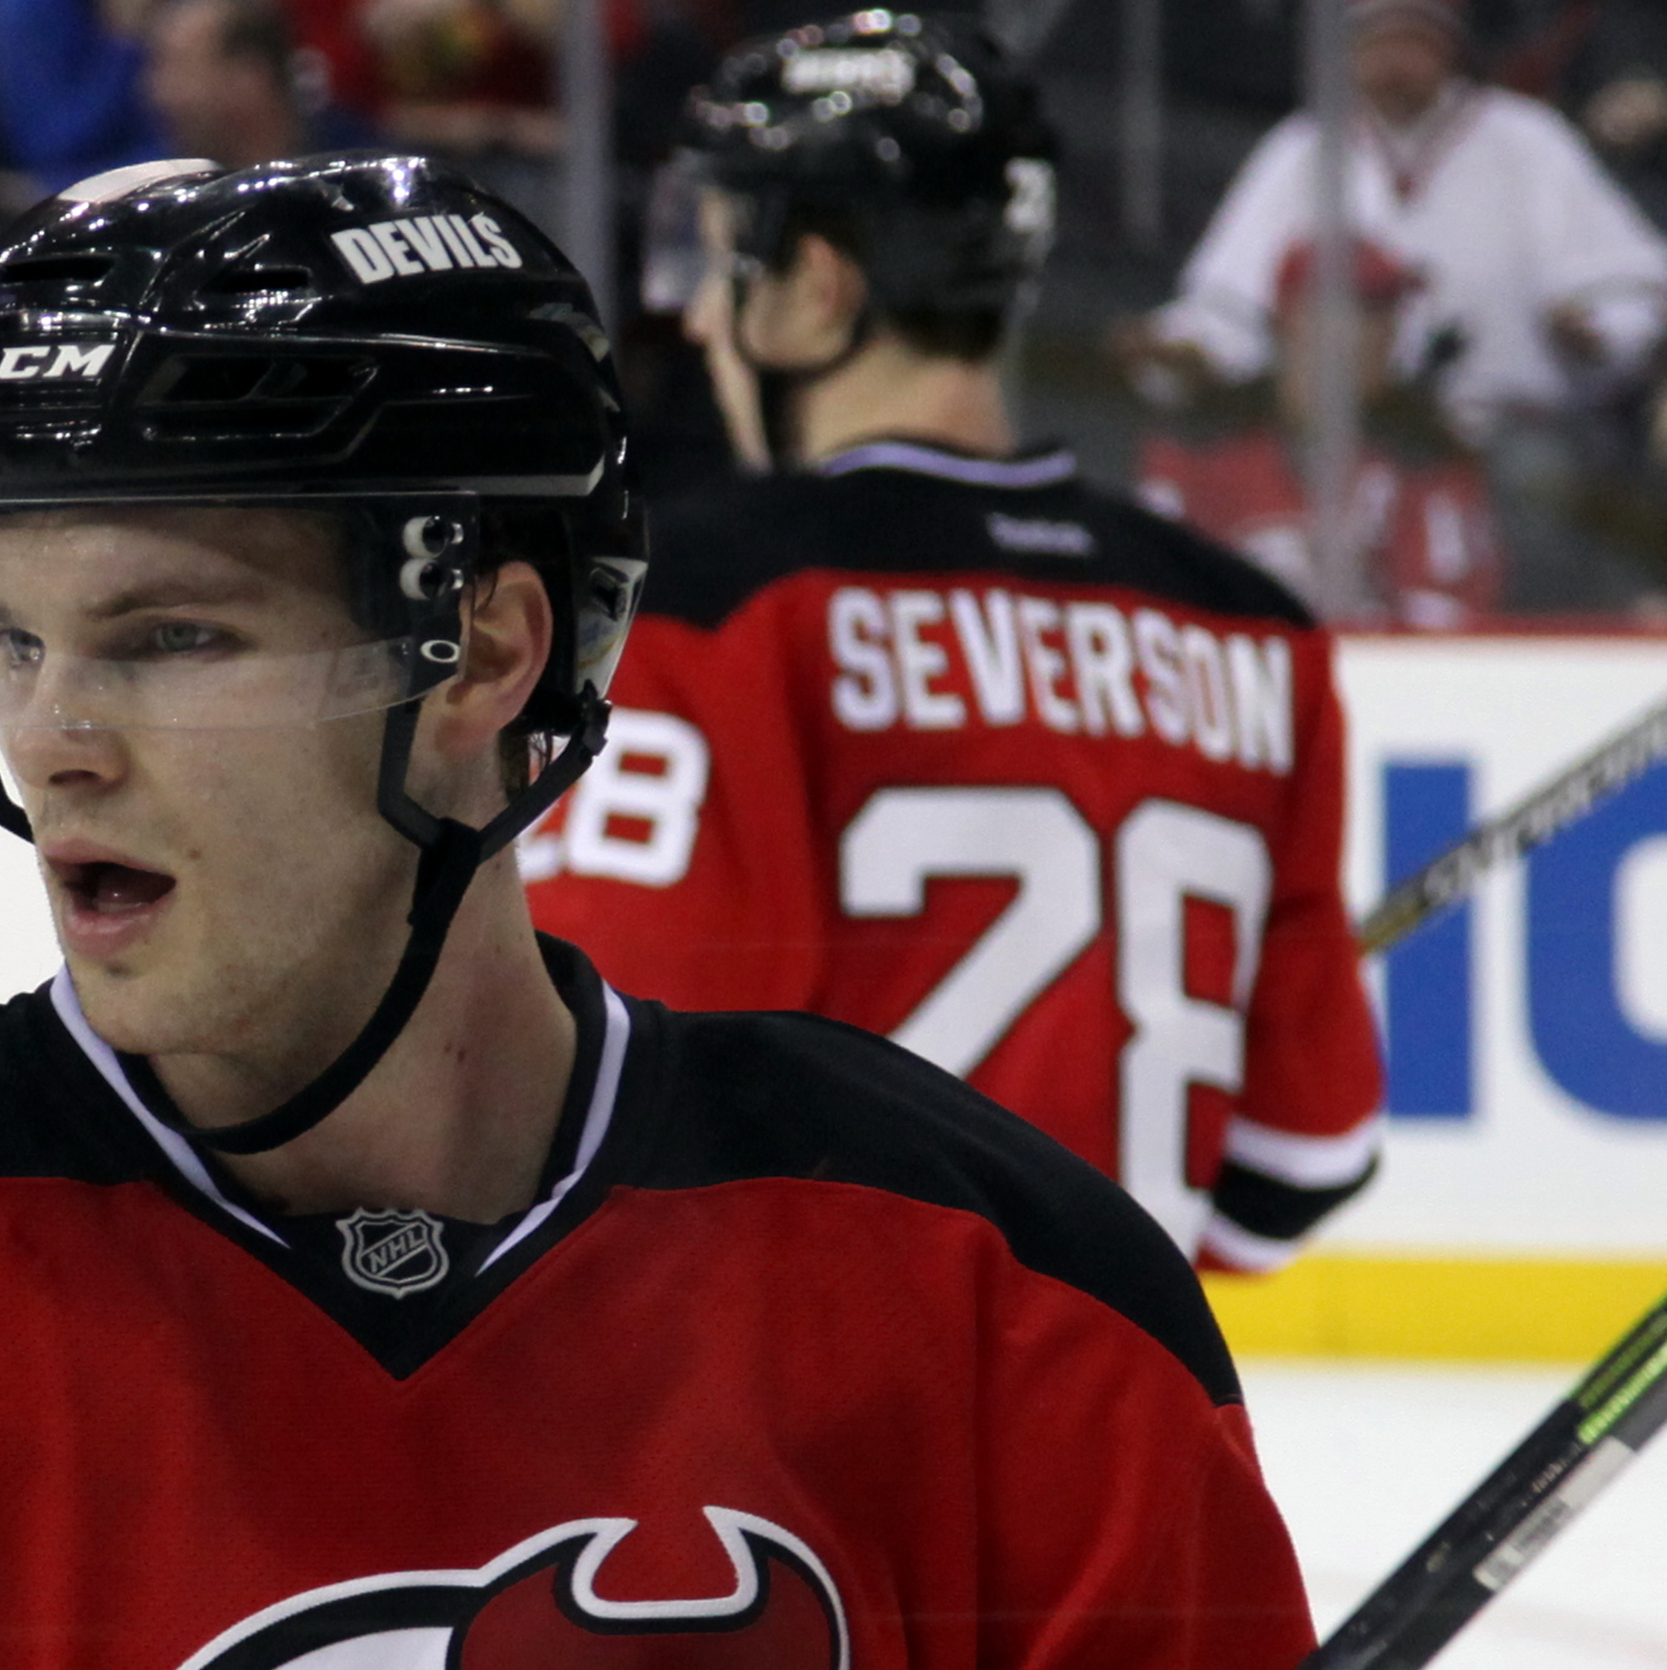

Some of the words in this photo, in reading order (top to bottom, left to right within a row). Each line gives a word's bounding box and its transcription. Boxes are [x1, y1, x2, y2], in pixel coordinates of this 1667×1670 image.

[330, 211, 522, 284] DEVILS
[828, 587, 1295, 776] SEVERSON
[515, 706, 711, 890] 8
[839, 786, 1272, 1264] 28
[368, 1229, 420, 1274] NHL
